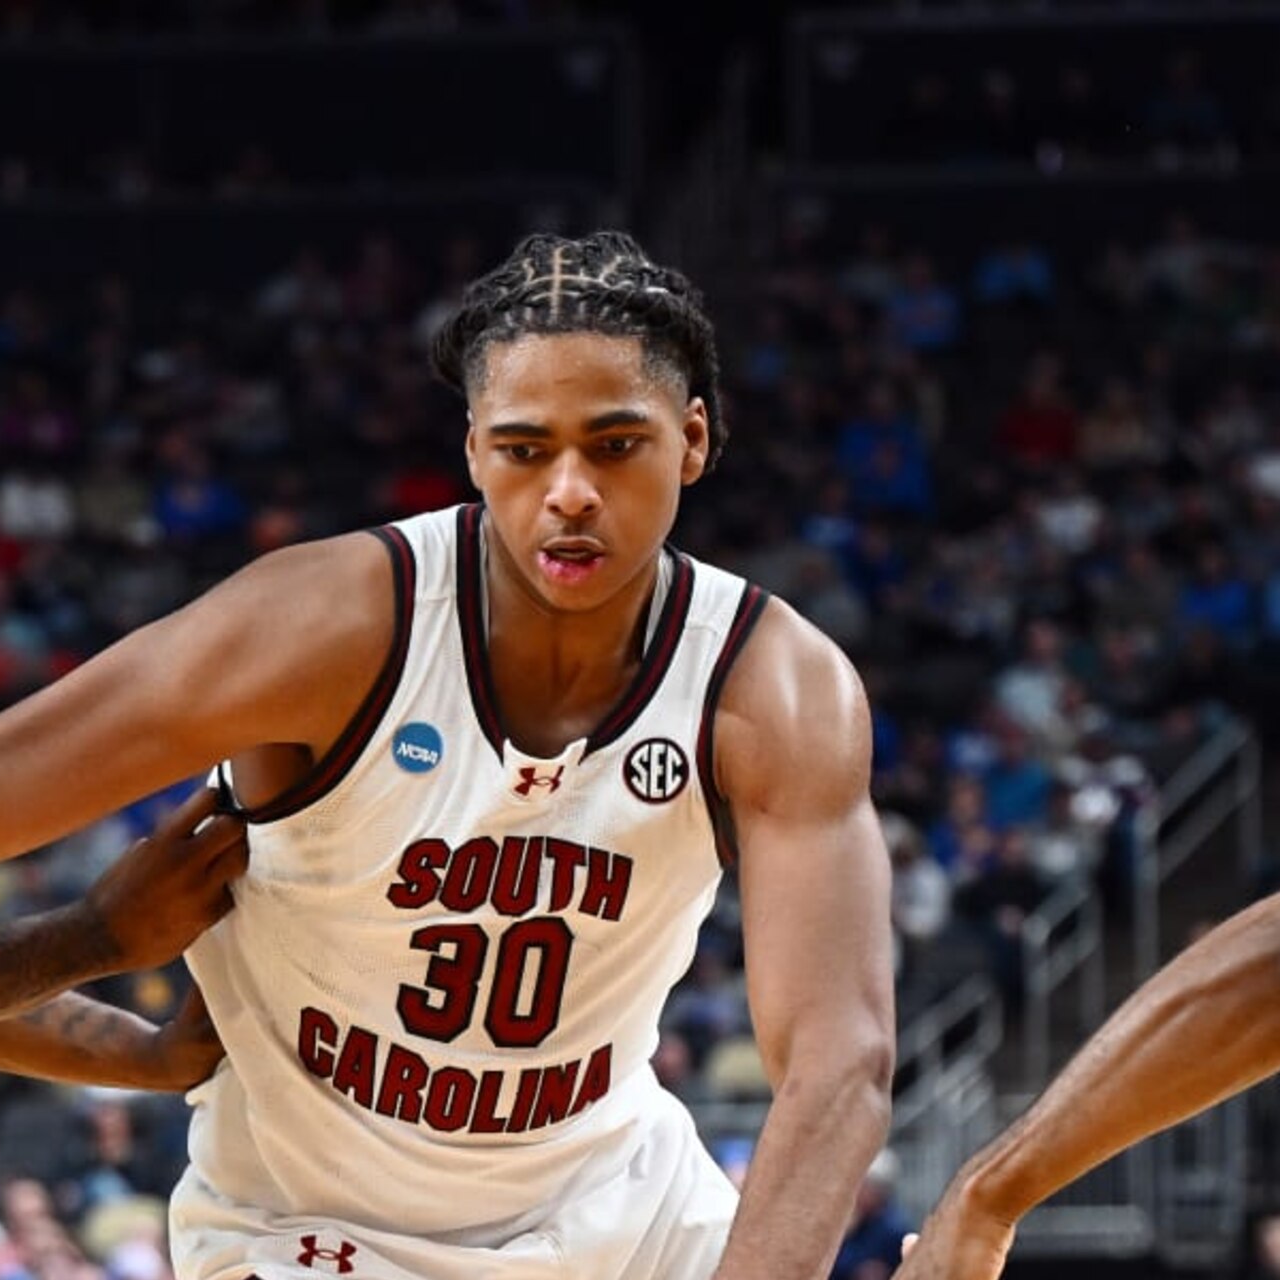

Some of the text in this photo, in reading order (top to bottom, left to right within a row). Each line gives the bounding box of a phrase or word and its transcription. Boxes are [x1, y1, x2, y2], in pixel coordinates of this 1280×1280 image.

[396, 741, 439, 767] NCAA
[631, 742, 683, 799] SEC
[385, 835, 635, 922] SOUTH
[395, 916, 576, 1049] 30
[296, 1005, 614, 1134] CAROLINA
